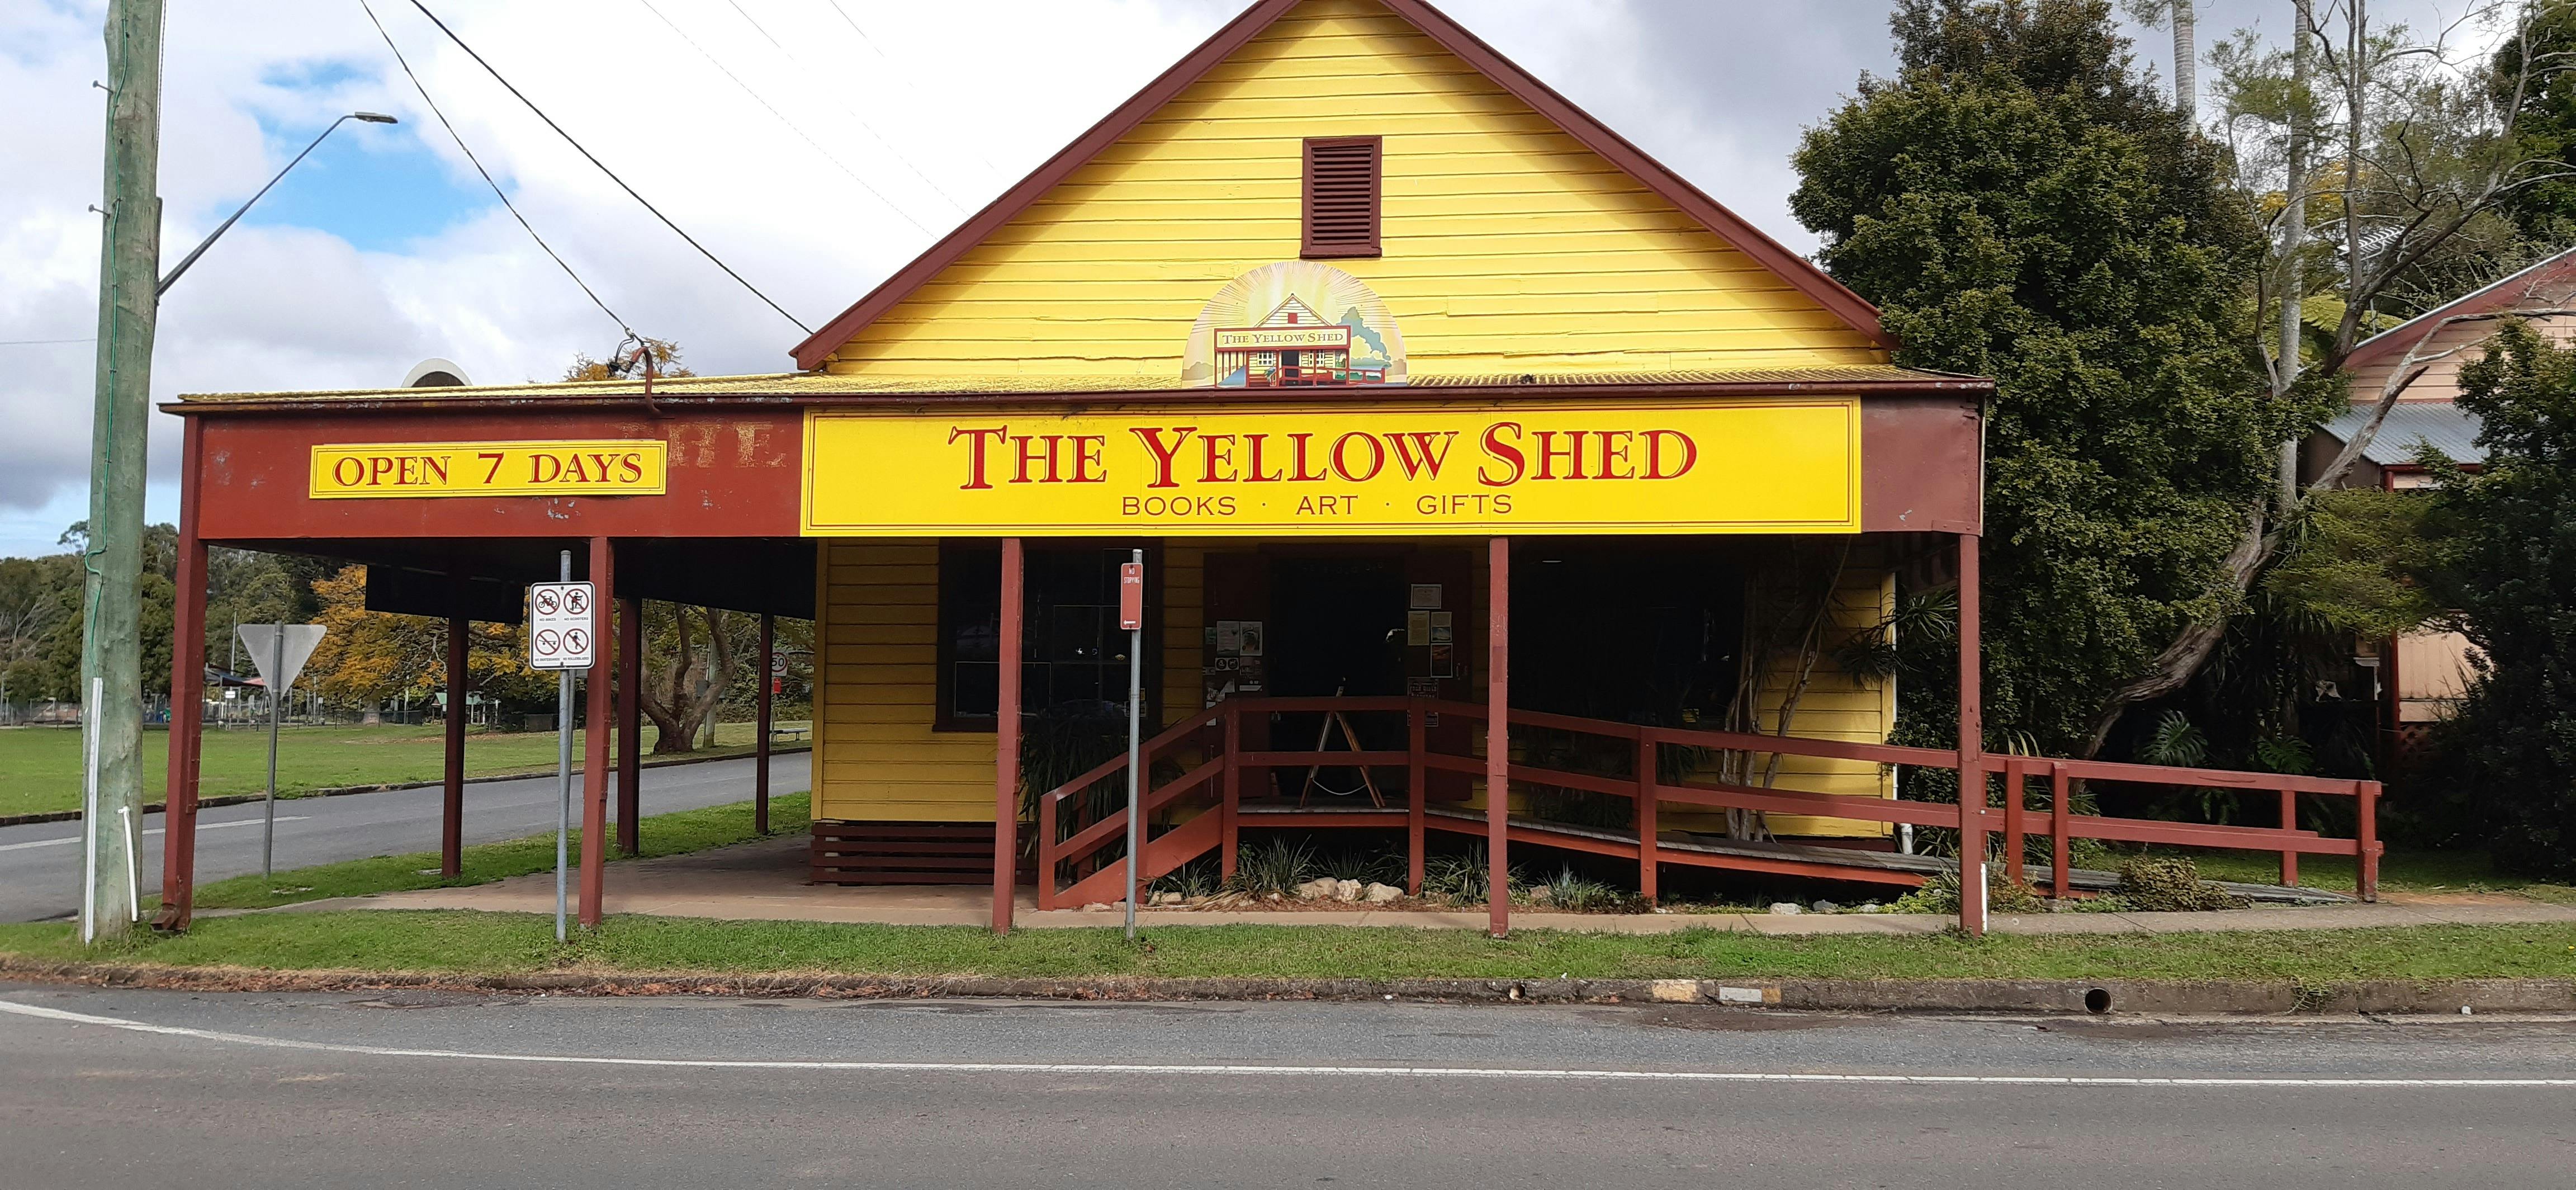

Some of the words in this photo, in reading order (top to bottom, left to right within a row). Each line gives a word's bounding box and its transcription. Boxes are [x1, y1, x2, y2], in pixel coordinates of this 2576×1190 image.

[1223, 334, 1249, 344] THE
[1252, 333, 1306, 343] YELLOW
[1308, 333, 1344, 343] SHED
[332, 455, 451, 487] OPEN
[477, 451, 505, 485] 7
[527, 452, 643, 484] DAYS
[948, 424, 1108, 490] THE
[1128, 426, 1460, 489] YELLOW
[1478, 422, 1697, 487] SHED
[1121, 496, 1237, 516] BOOKS
[1295, 495, 1358, 515] ART
[1416, 494, 1512, 515] GIFTS
